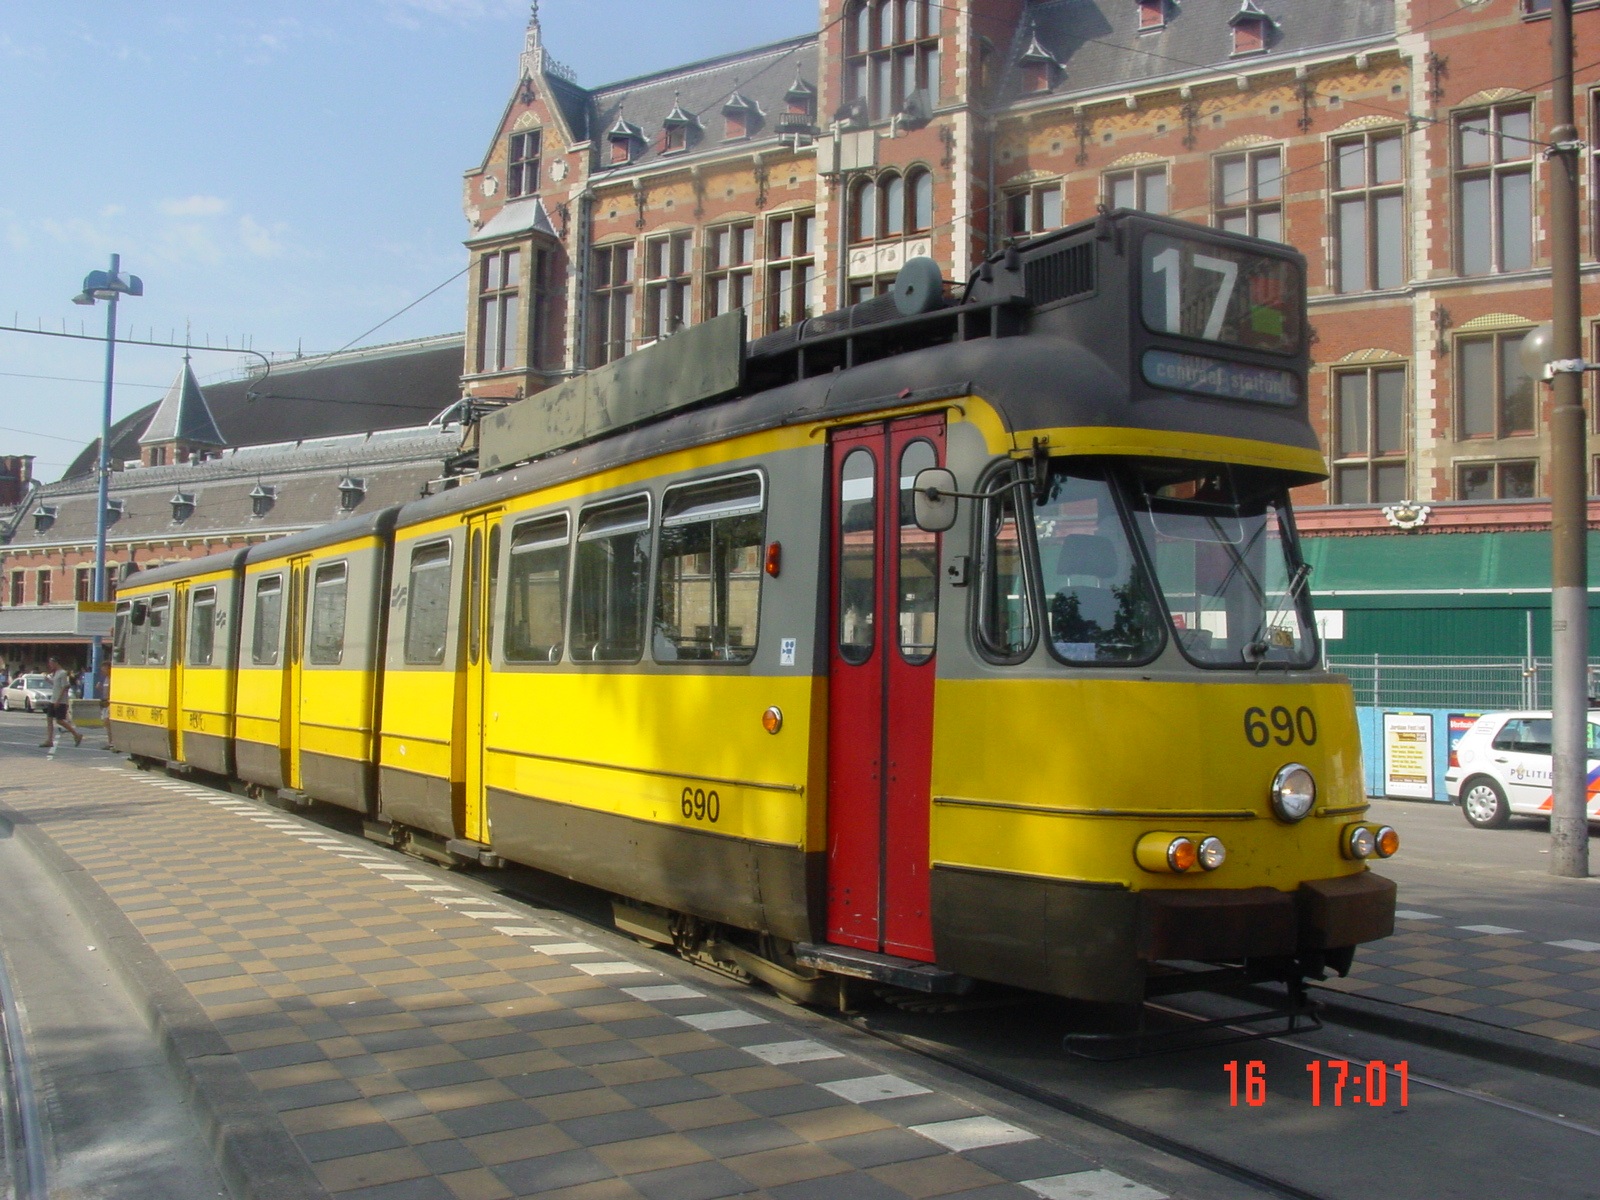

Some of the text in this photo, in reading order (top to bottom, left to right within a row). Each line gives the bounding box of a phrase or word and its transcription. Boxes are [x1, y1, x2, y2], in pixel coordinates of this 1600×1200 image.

[1153, 248, 1238, 341] 17
[1243, 705, 1317, 748] 690
[681, 786, 720, 823] 690
